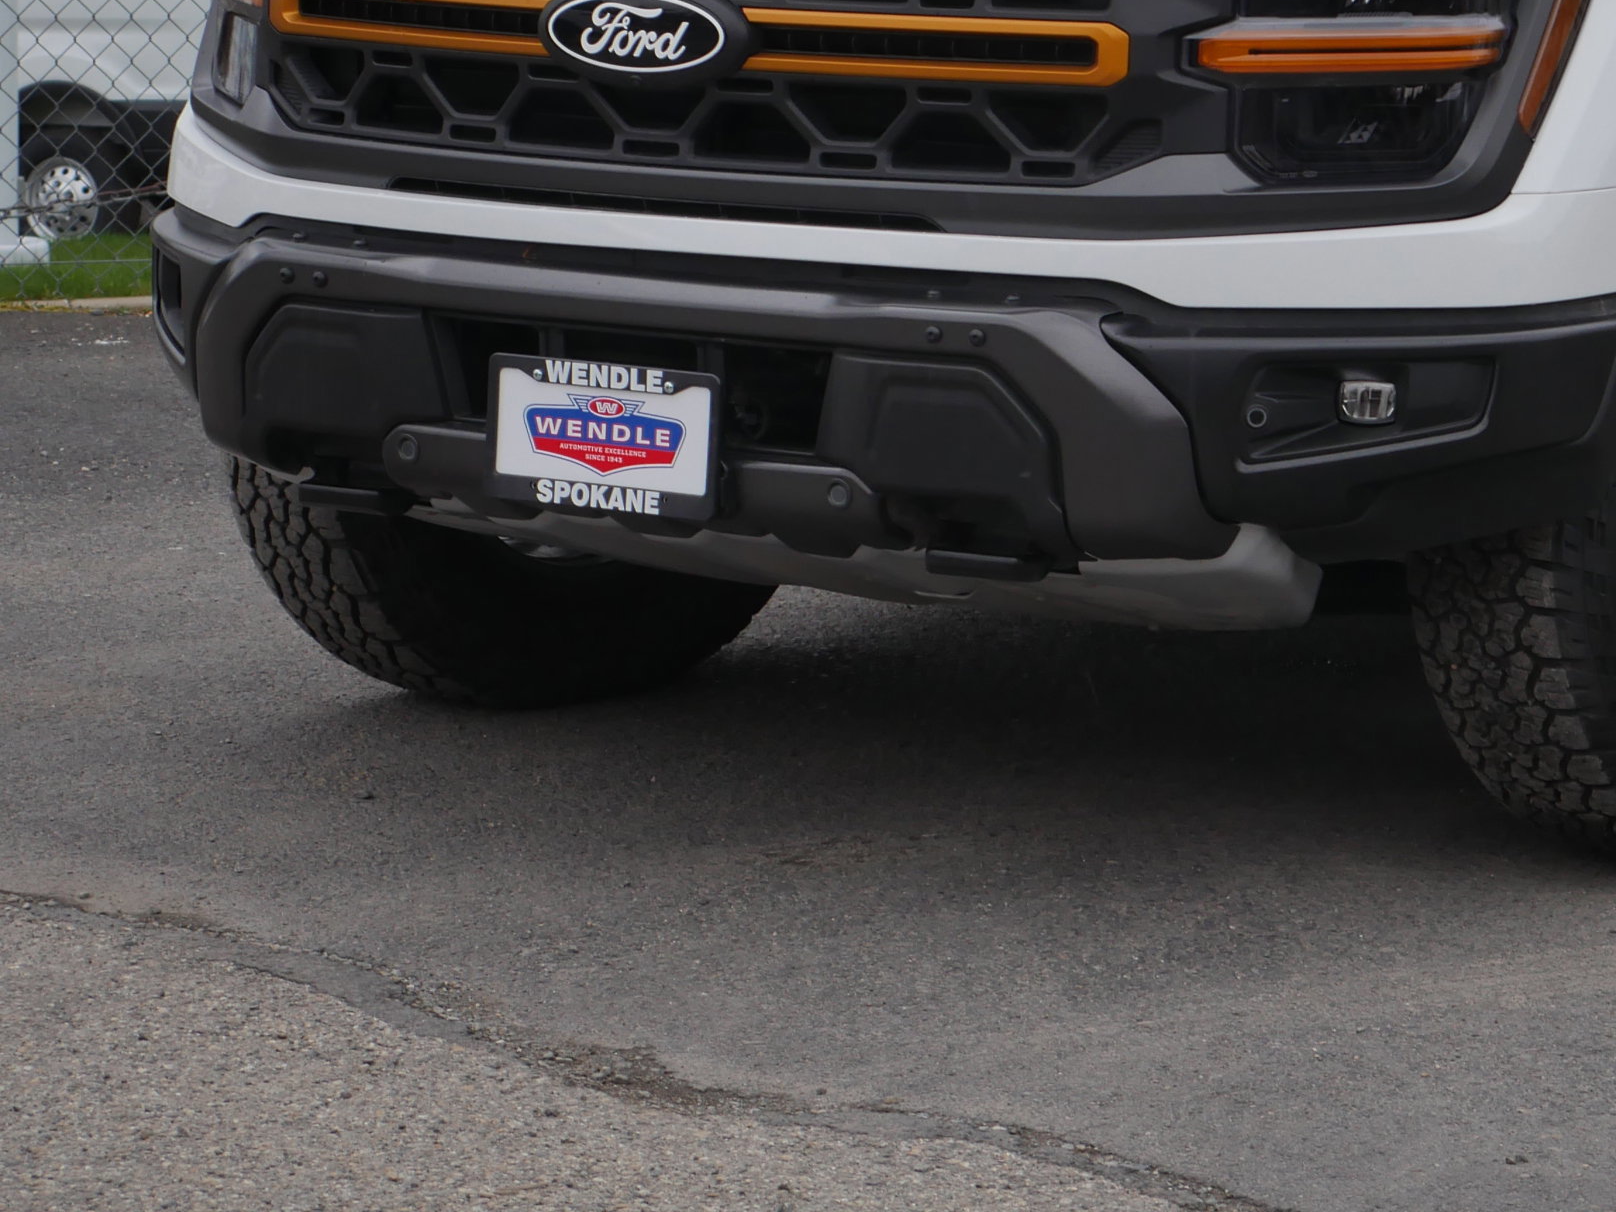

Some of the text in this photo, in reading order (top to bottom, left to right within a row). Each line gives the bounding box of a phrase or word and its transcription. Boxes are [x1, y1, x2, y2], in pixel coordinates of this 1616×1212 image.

[580, 2, 690, 60] Ford
[545, 359, 664, 394] WENDLE
[535, 415, 671, 448] WENDLE
[560, 442, 647, 458] AUTOMOTIVE EXCELLENCE
[585, 453, 623, 464] SINCE 1943
[536, 478, 660, 515] SPOKANE
